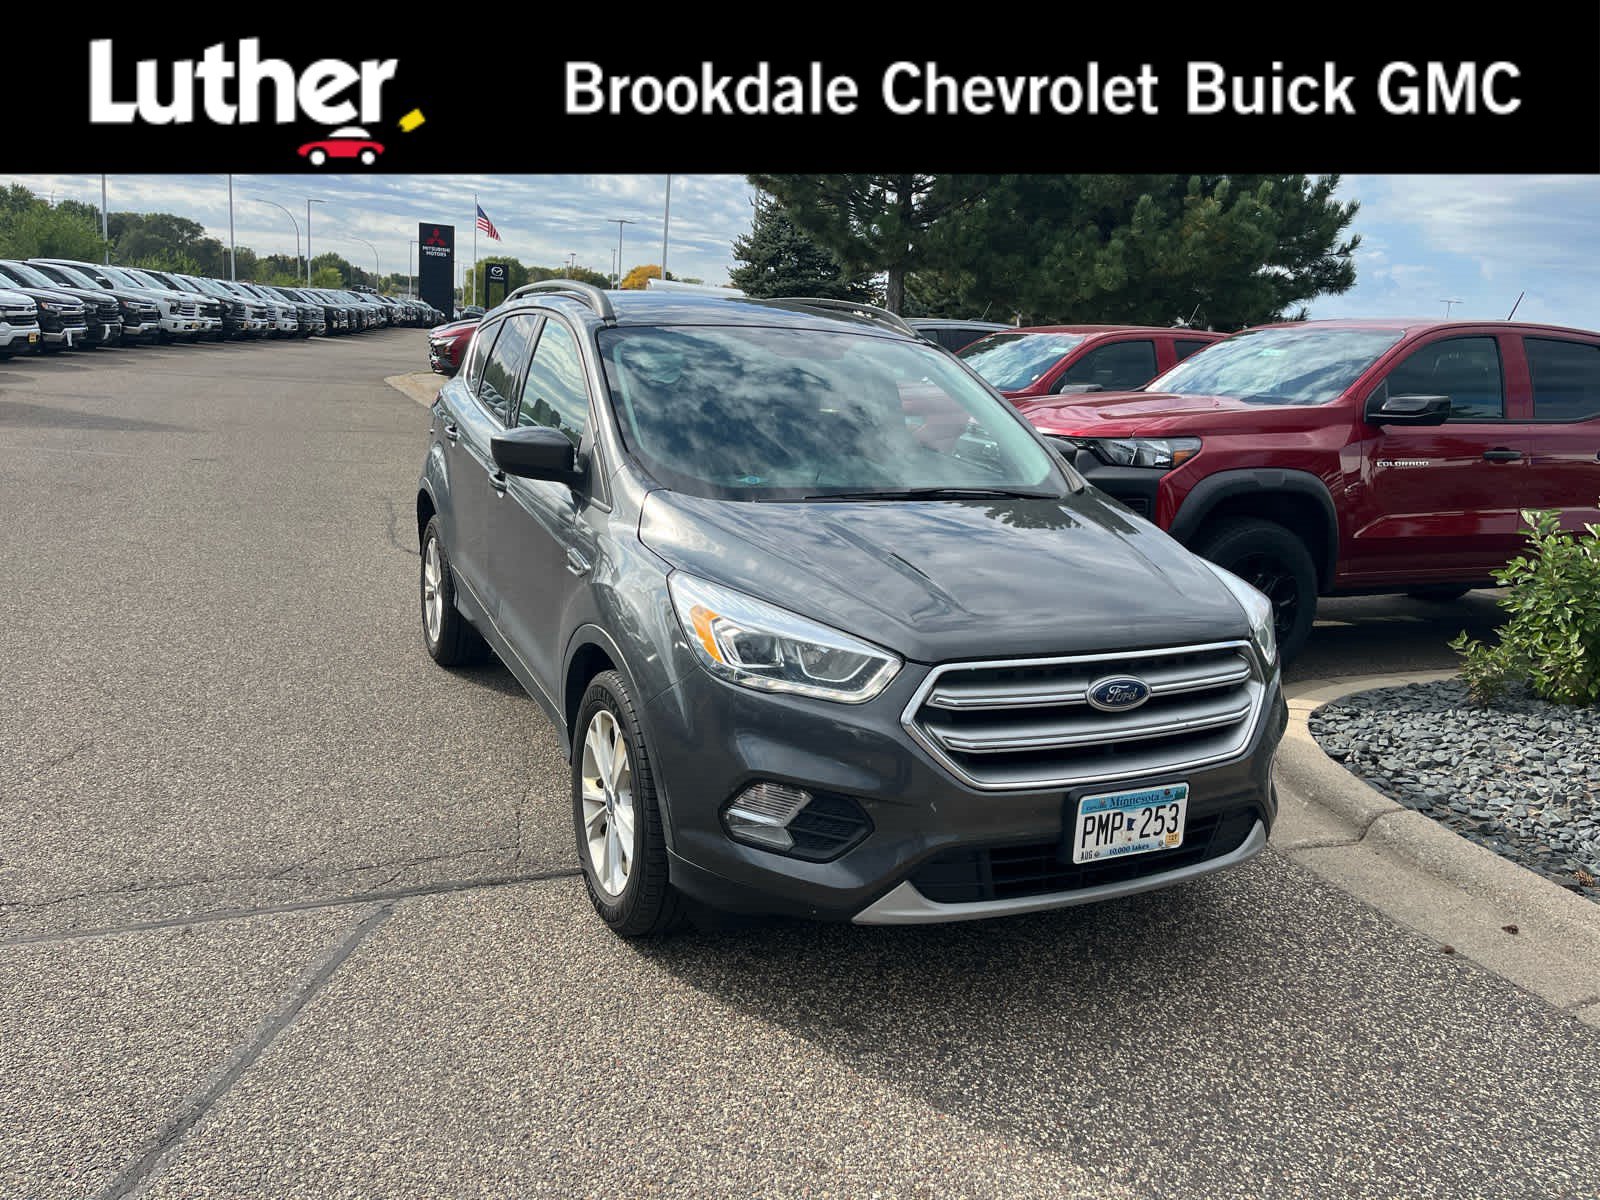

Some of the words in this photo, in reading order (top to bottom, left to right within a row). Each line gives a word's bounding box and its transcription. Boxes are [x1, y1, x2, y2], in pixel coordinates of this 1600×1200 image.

[1106, 685, 1138, 703] Ford
[1110, 792, 1160, 807] Minnesota
[1081, 811, 1124, 848] PMP
[1139, 803, 1180, 838] 253
[1081, 850, 1093, 860] AUG
[1109, 846, 1131, 855] 10,000
